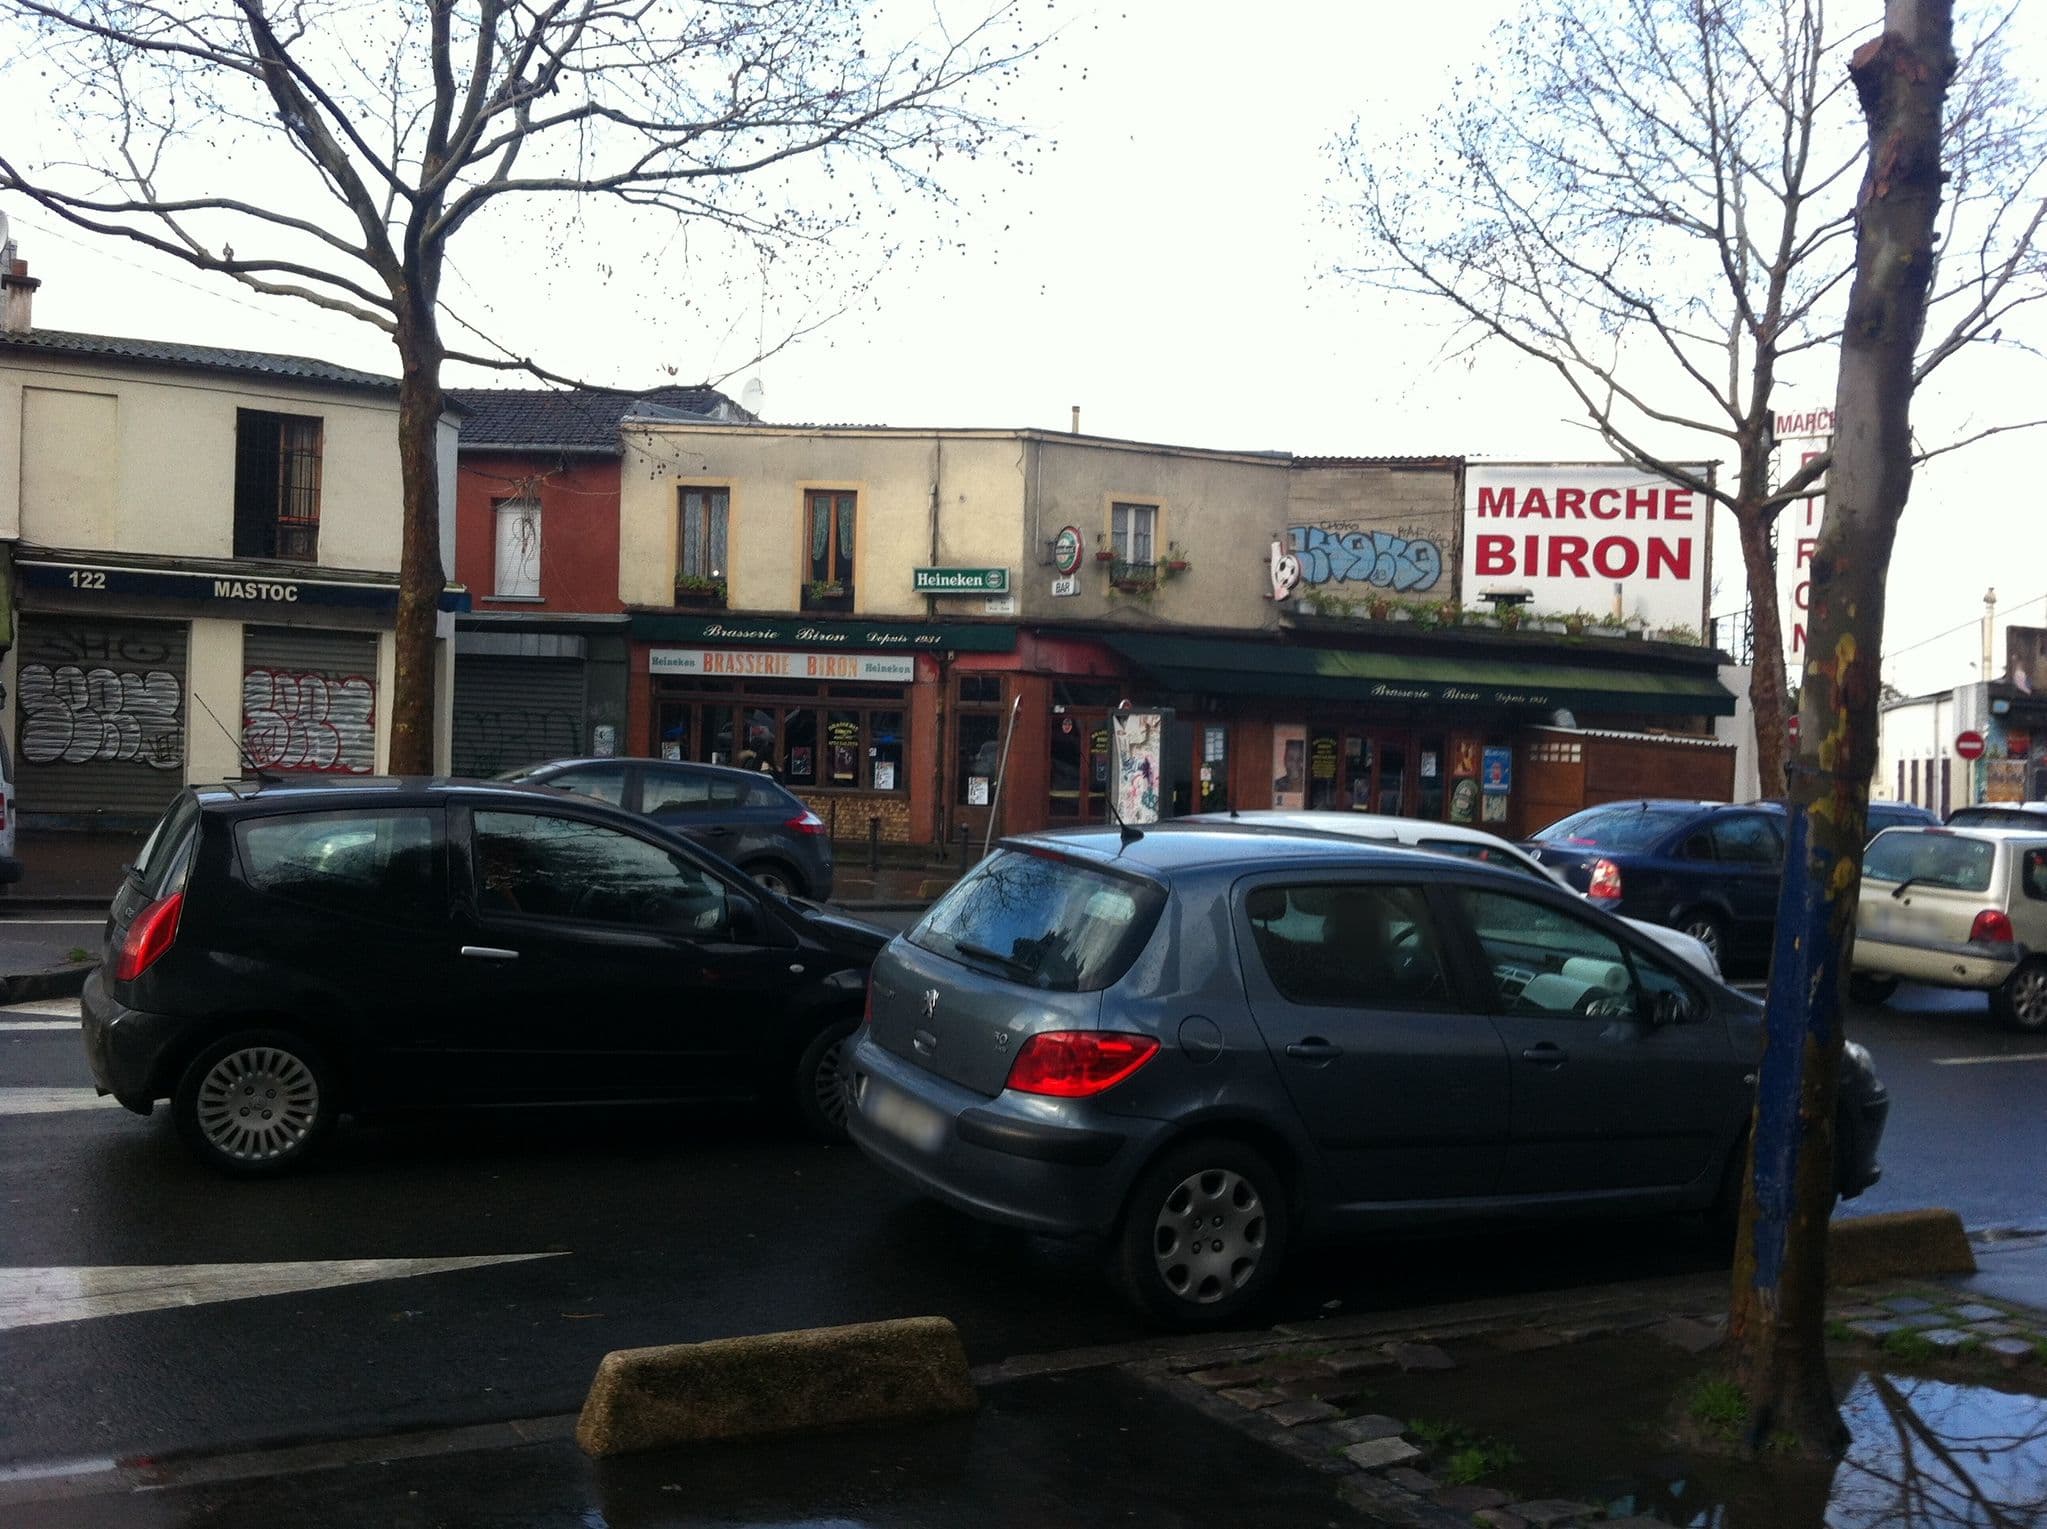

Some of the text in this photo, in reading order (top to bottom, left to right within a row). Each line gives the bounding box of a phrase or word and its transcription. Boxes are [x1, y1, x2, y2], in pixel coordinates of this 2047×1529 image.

[1477, 487, 1694, 520] MARCHE
[1475, 534, 1692, 580] BIRON
[69, 571, 106, 590] 122
[917, 572, 983, 587] Heineken
[1055, 582, 1071, 594] BAR
[214, 580, 298, 601] MASTOC
[703, 624, 779, 640] Brasserie
[796, 627, 849, 641] Biron
[866, 631, 908, 645] Depuis
[651, 656, 696, 668] Heineken
[703, 652, 858, 678] BRASSERIE BIRON
[865, 662, 912, 675] Heineken
